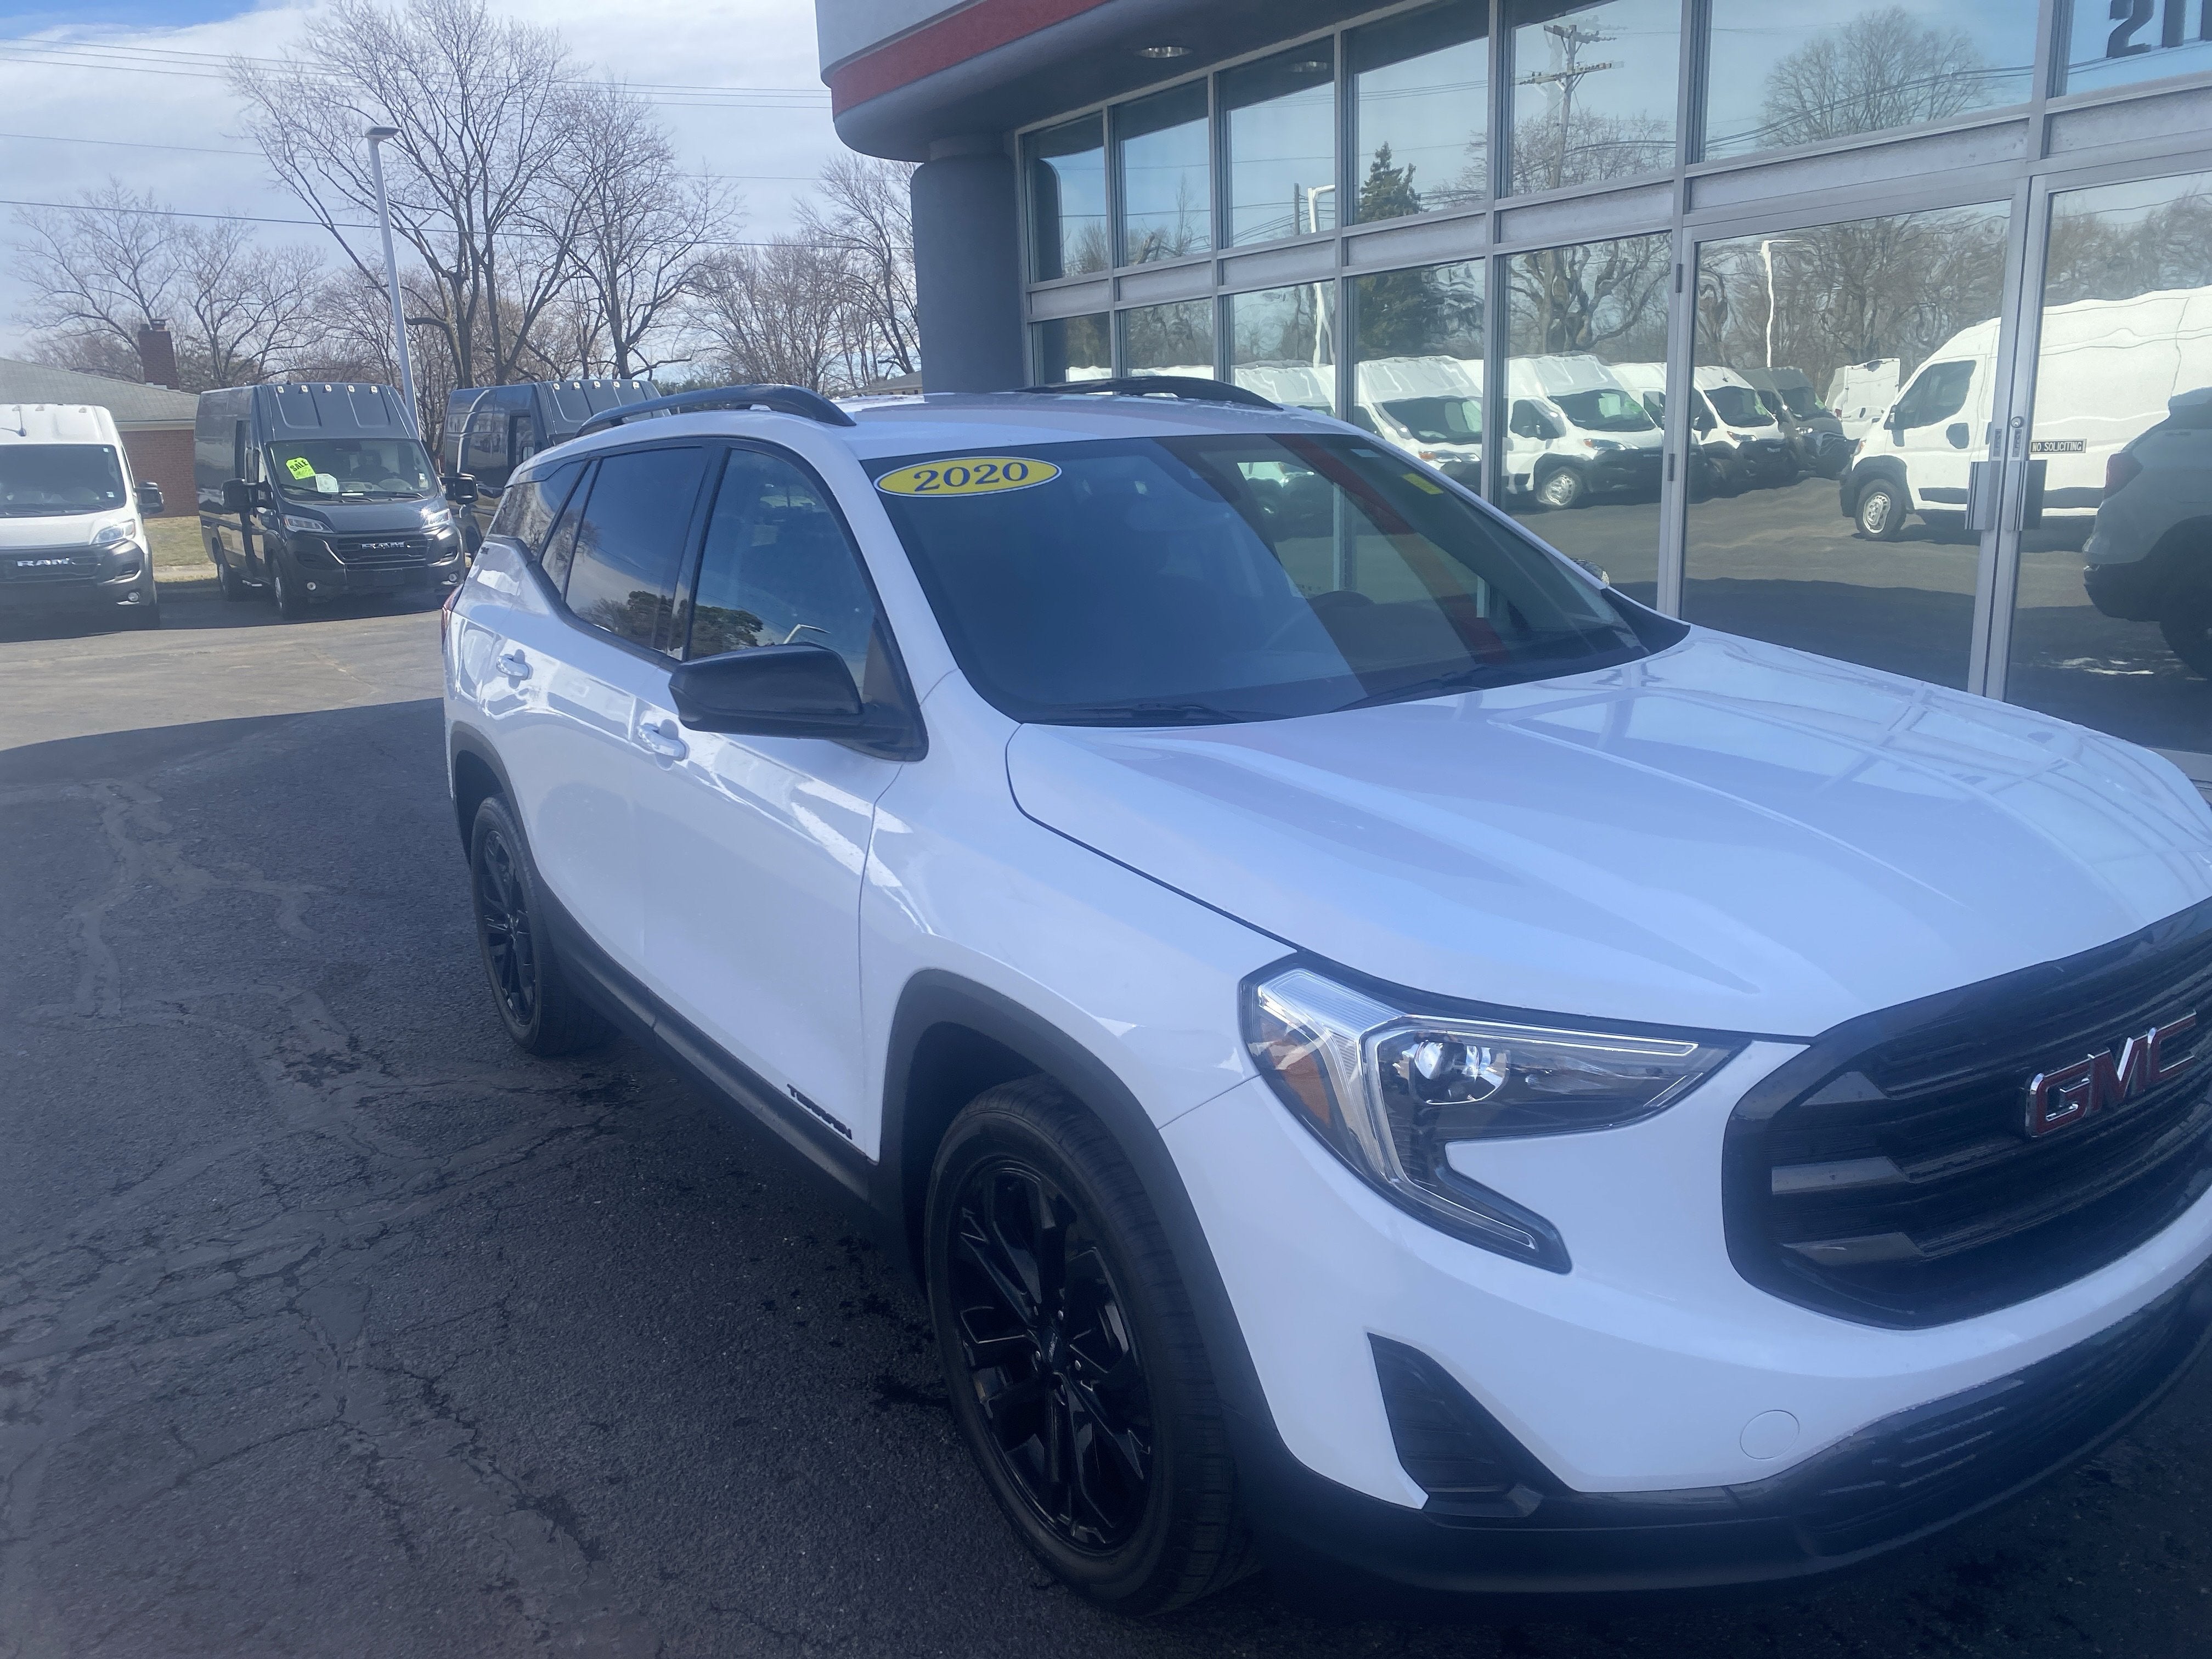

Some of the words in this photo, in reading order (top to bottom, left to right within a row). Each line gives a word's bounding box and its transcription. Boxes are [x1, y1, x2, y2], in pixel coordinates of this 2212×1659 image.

[2032, 442, 2041, 452] NO
[2044, 441, 2082, 452] SOLICITING
[290, 460, 308, 471] SALE
[913, 462, 1029, 492] 2020
[361, 541, 405, 549] RAM
[17, 557, 70, 567] RAM
[2025, 1009, 2197, 1138] GMC
